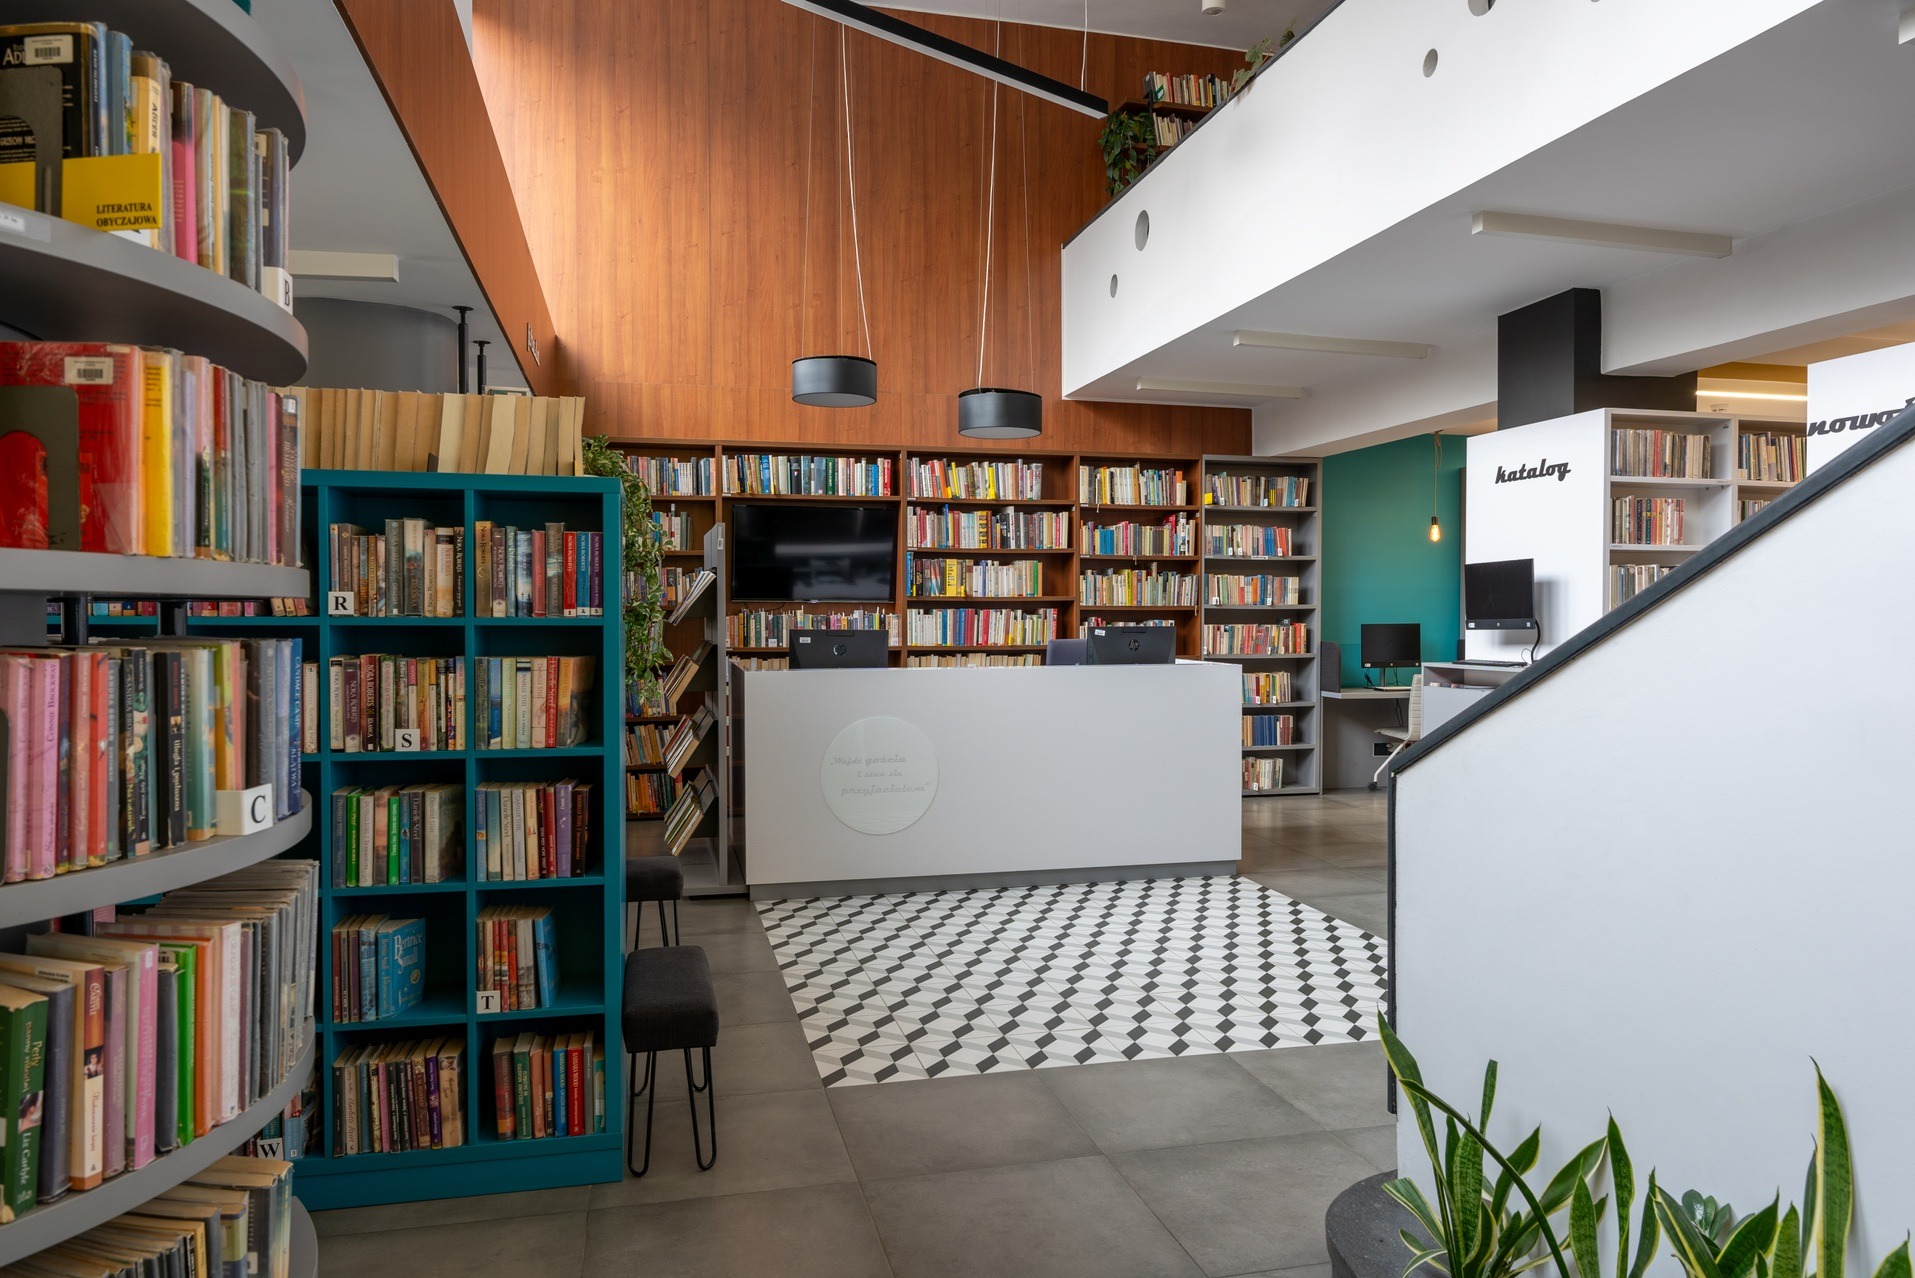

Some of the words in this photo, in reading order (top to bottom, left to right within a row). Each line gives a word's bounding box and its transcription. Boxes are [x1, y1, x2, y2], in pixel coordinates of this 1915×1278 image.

[96, 203, 152, 214] LITERATURA
[96, 216, 157, 228] OBYCZAJOWA
[284, 279, 290, 307] B
[1807, 397, 1915, 437] nowo
[1495, 458, 1572, 484] katalog
[456, 536, 464, 551] NORA
[456, 552, 464, 573] ROBERTS
[333, 596, 349, 611] R
[366, 664, 375, 681] NORA
[47, 663, 56, 708] BROCKWAY
[125, 676, 134, 711] SANDRA
[350, 680, 358, 698] NORA
[366, 681, 375, 706] ROBERTS
[350, 699, 358, 722] ROBERTS
[46, 711, 55, 743] CONNIE
[125, 713, 134, 745] BROWN
[401, 733, 412, 748] S
[250, 795, 267, 824] C
[412, 797, 420, 823] Danielle
[503, 796, 511, 821] Danielle
[412, 824, 420, 840] Steel
[503, 822, 511, 838] Steel
[394, 932, 423, 960] Bertrice
[397, 946, 418, 975] Small
[481, 995, 494, 1010] T
[346, 1097, 354, 1124] Charlotte
[21, 1132, 32, 1147] Liz
[259, 1142, 280, 1158] W
[19, 1149, 31, 1185] Carlyle
